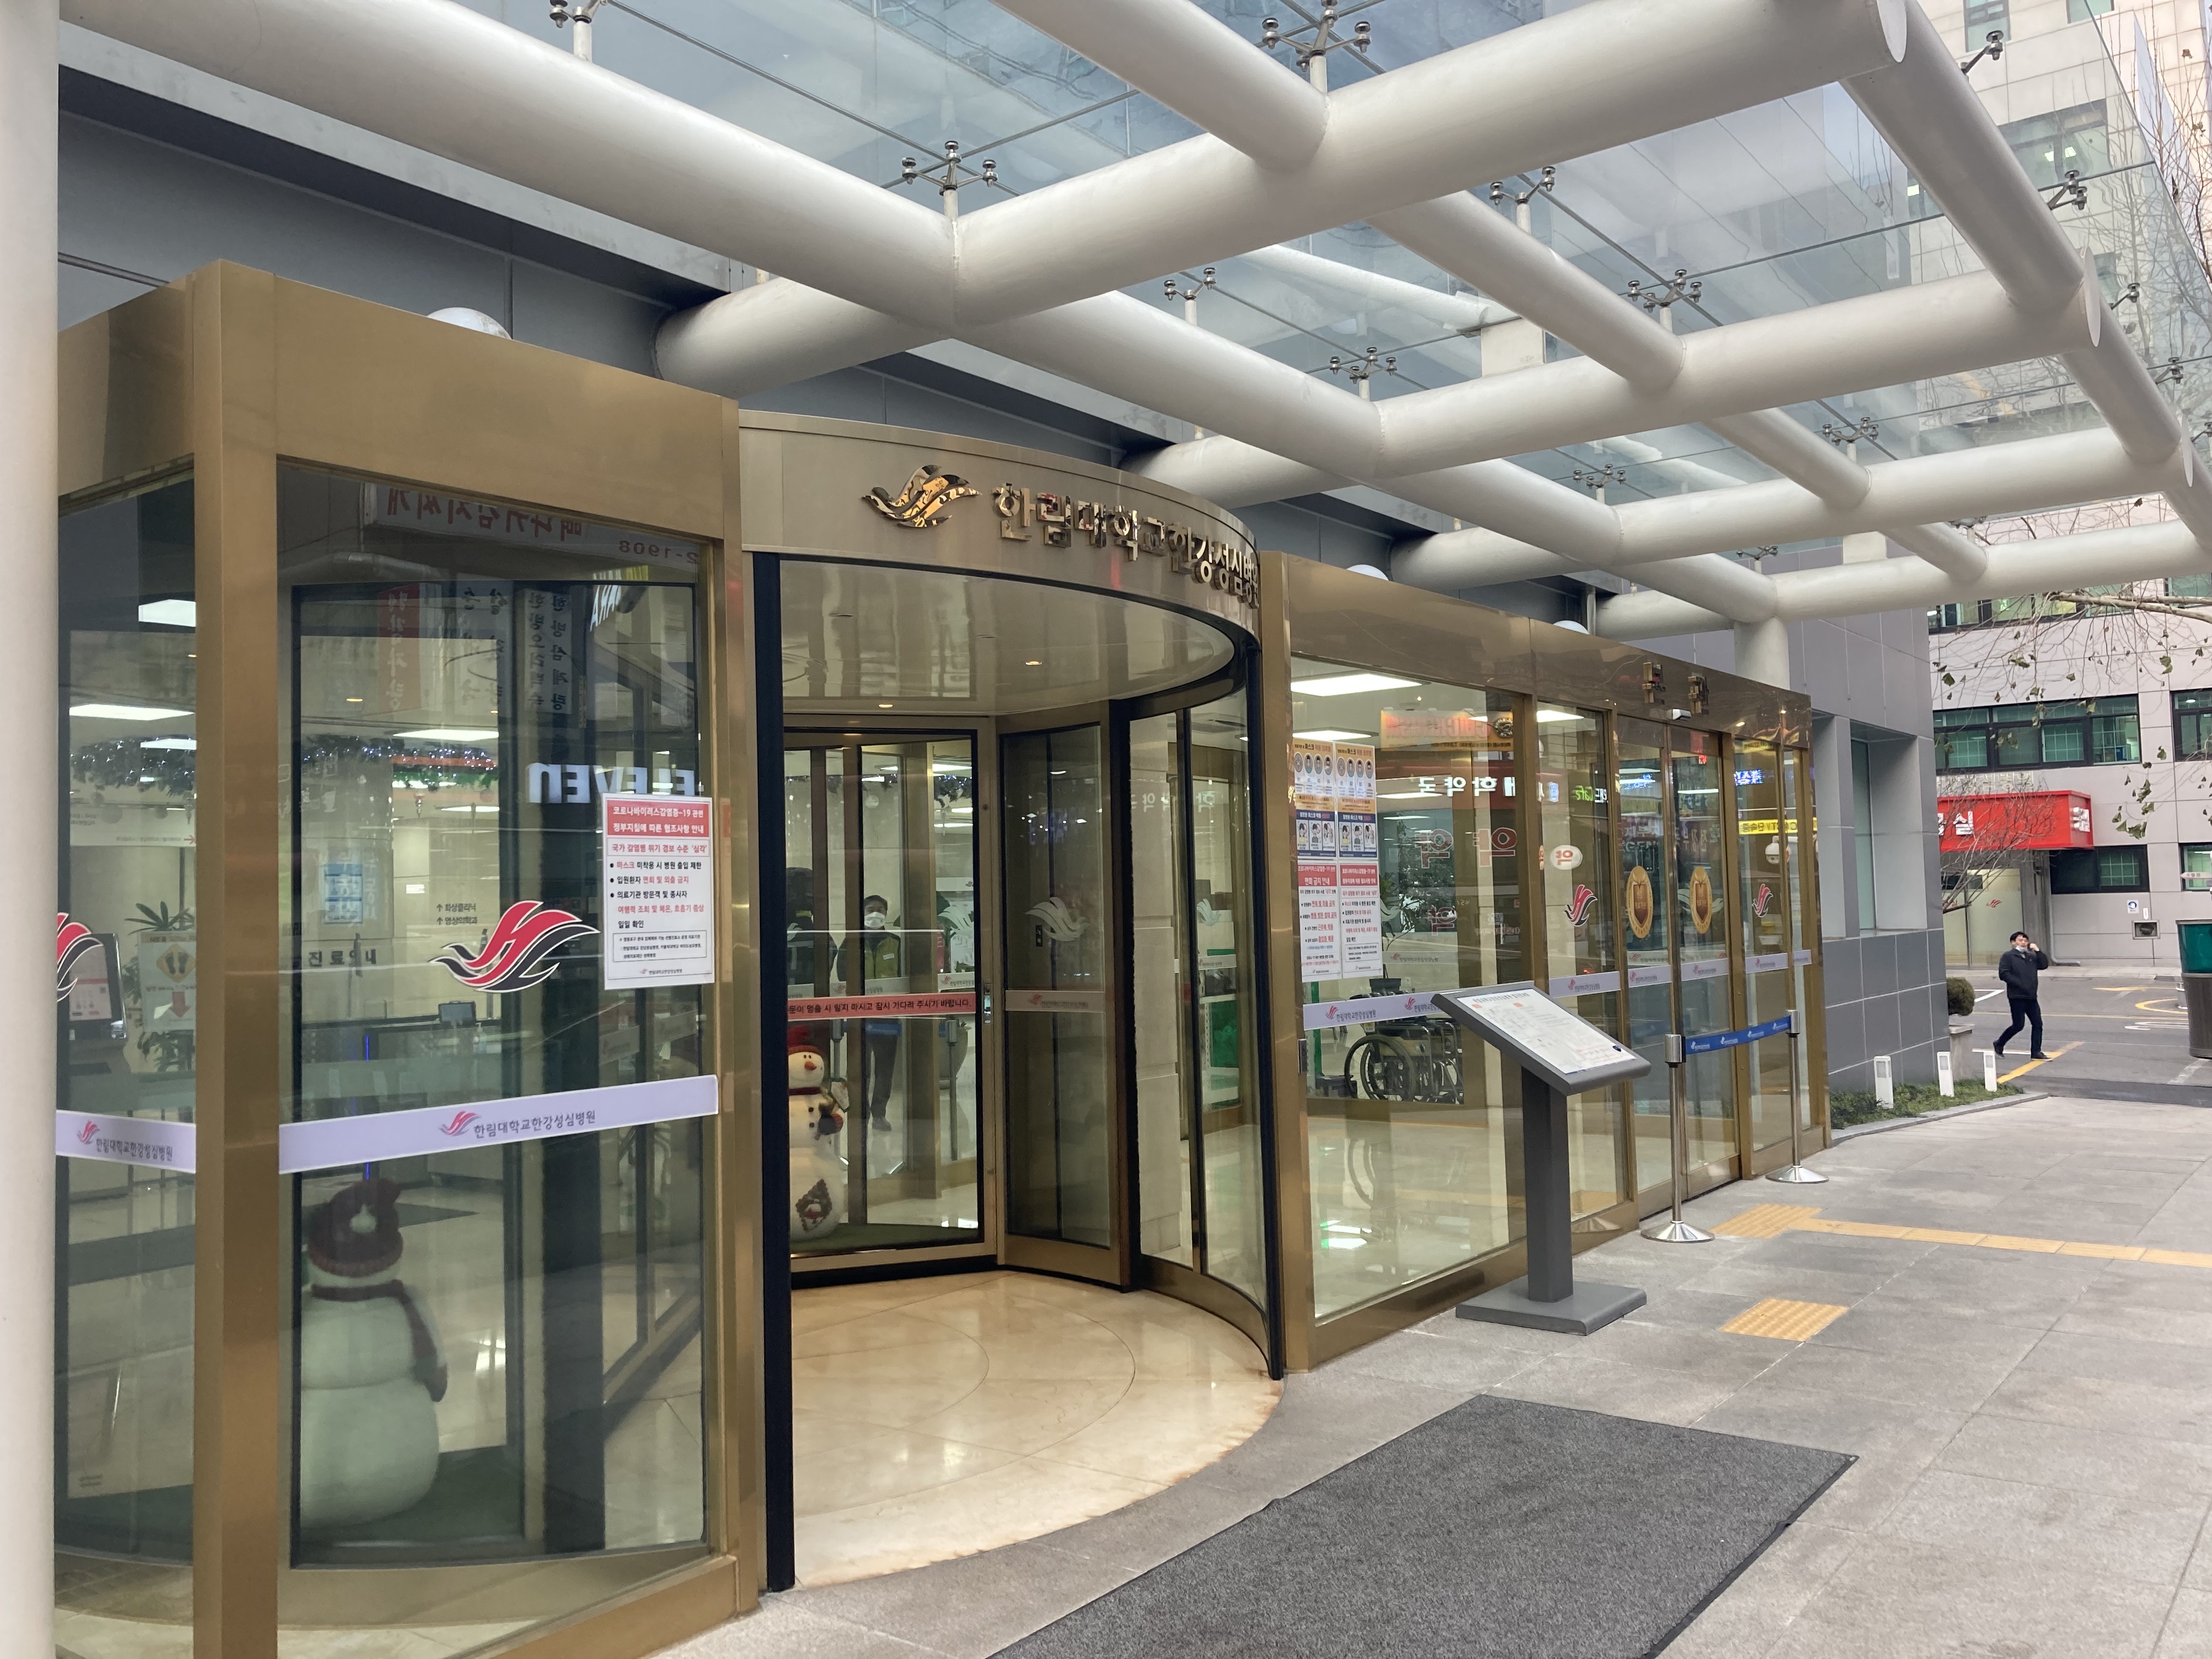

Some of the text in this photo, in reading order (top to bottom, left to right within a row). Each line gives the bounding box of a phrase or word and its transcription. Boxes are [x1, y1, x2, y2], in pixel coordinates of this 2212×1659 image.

[992, 482, 1260, 609] 한림대학교한강성심병원
[613, 806, 704, 818] 코로나바이러스감염증-19 관련
[613, 823, 704, 834] 정부지침에 따른 협조사항 안내
[612, 844, 625, 853] 국가
[628, 844, 646, 853] 감염병
[648, 844, 661, 853] 위기
[663, 844, 675, 853] 경보
[677, 845, 689, 853] 수준
[617, 861, 635, 870] 마스크
[636, 861, 654, 870] 미착용
[664, 861, 675, 870] 병원
[678, 861, 689, 870] 출입
[690, 861, 702, 870] 제한
[617, 876, 641, 884] 입원환자
[643, 876, 655, 884] 면회
[678, 876, 689, 884] 금지
[670, 890, 687, 899] 종사자
[618, 905, 636, 914] 여행력
[675, 905, 691, 913] 호흡기
[693, 904, 704, 912] 증상
[618, 921, 630, 929] 일일
[825, 1004, 832, 1012] 시
[851, 1003, 872, 1011] 마시고
[876, 1002, 890, 1011] 잠시
[893, 1001, 915, 1009] 기다려
[917, 1000, 938, 1008] 주시기
[473, 1110, 596, 1139] 한림대학교한강성심병원
[95, 1138, 173, 1161] 한림대학교한강성심병원
